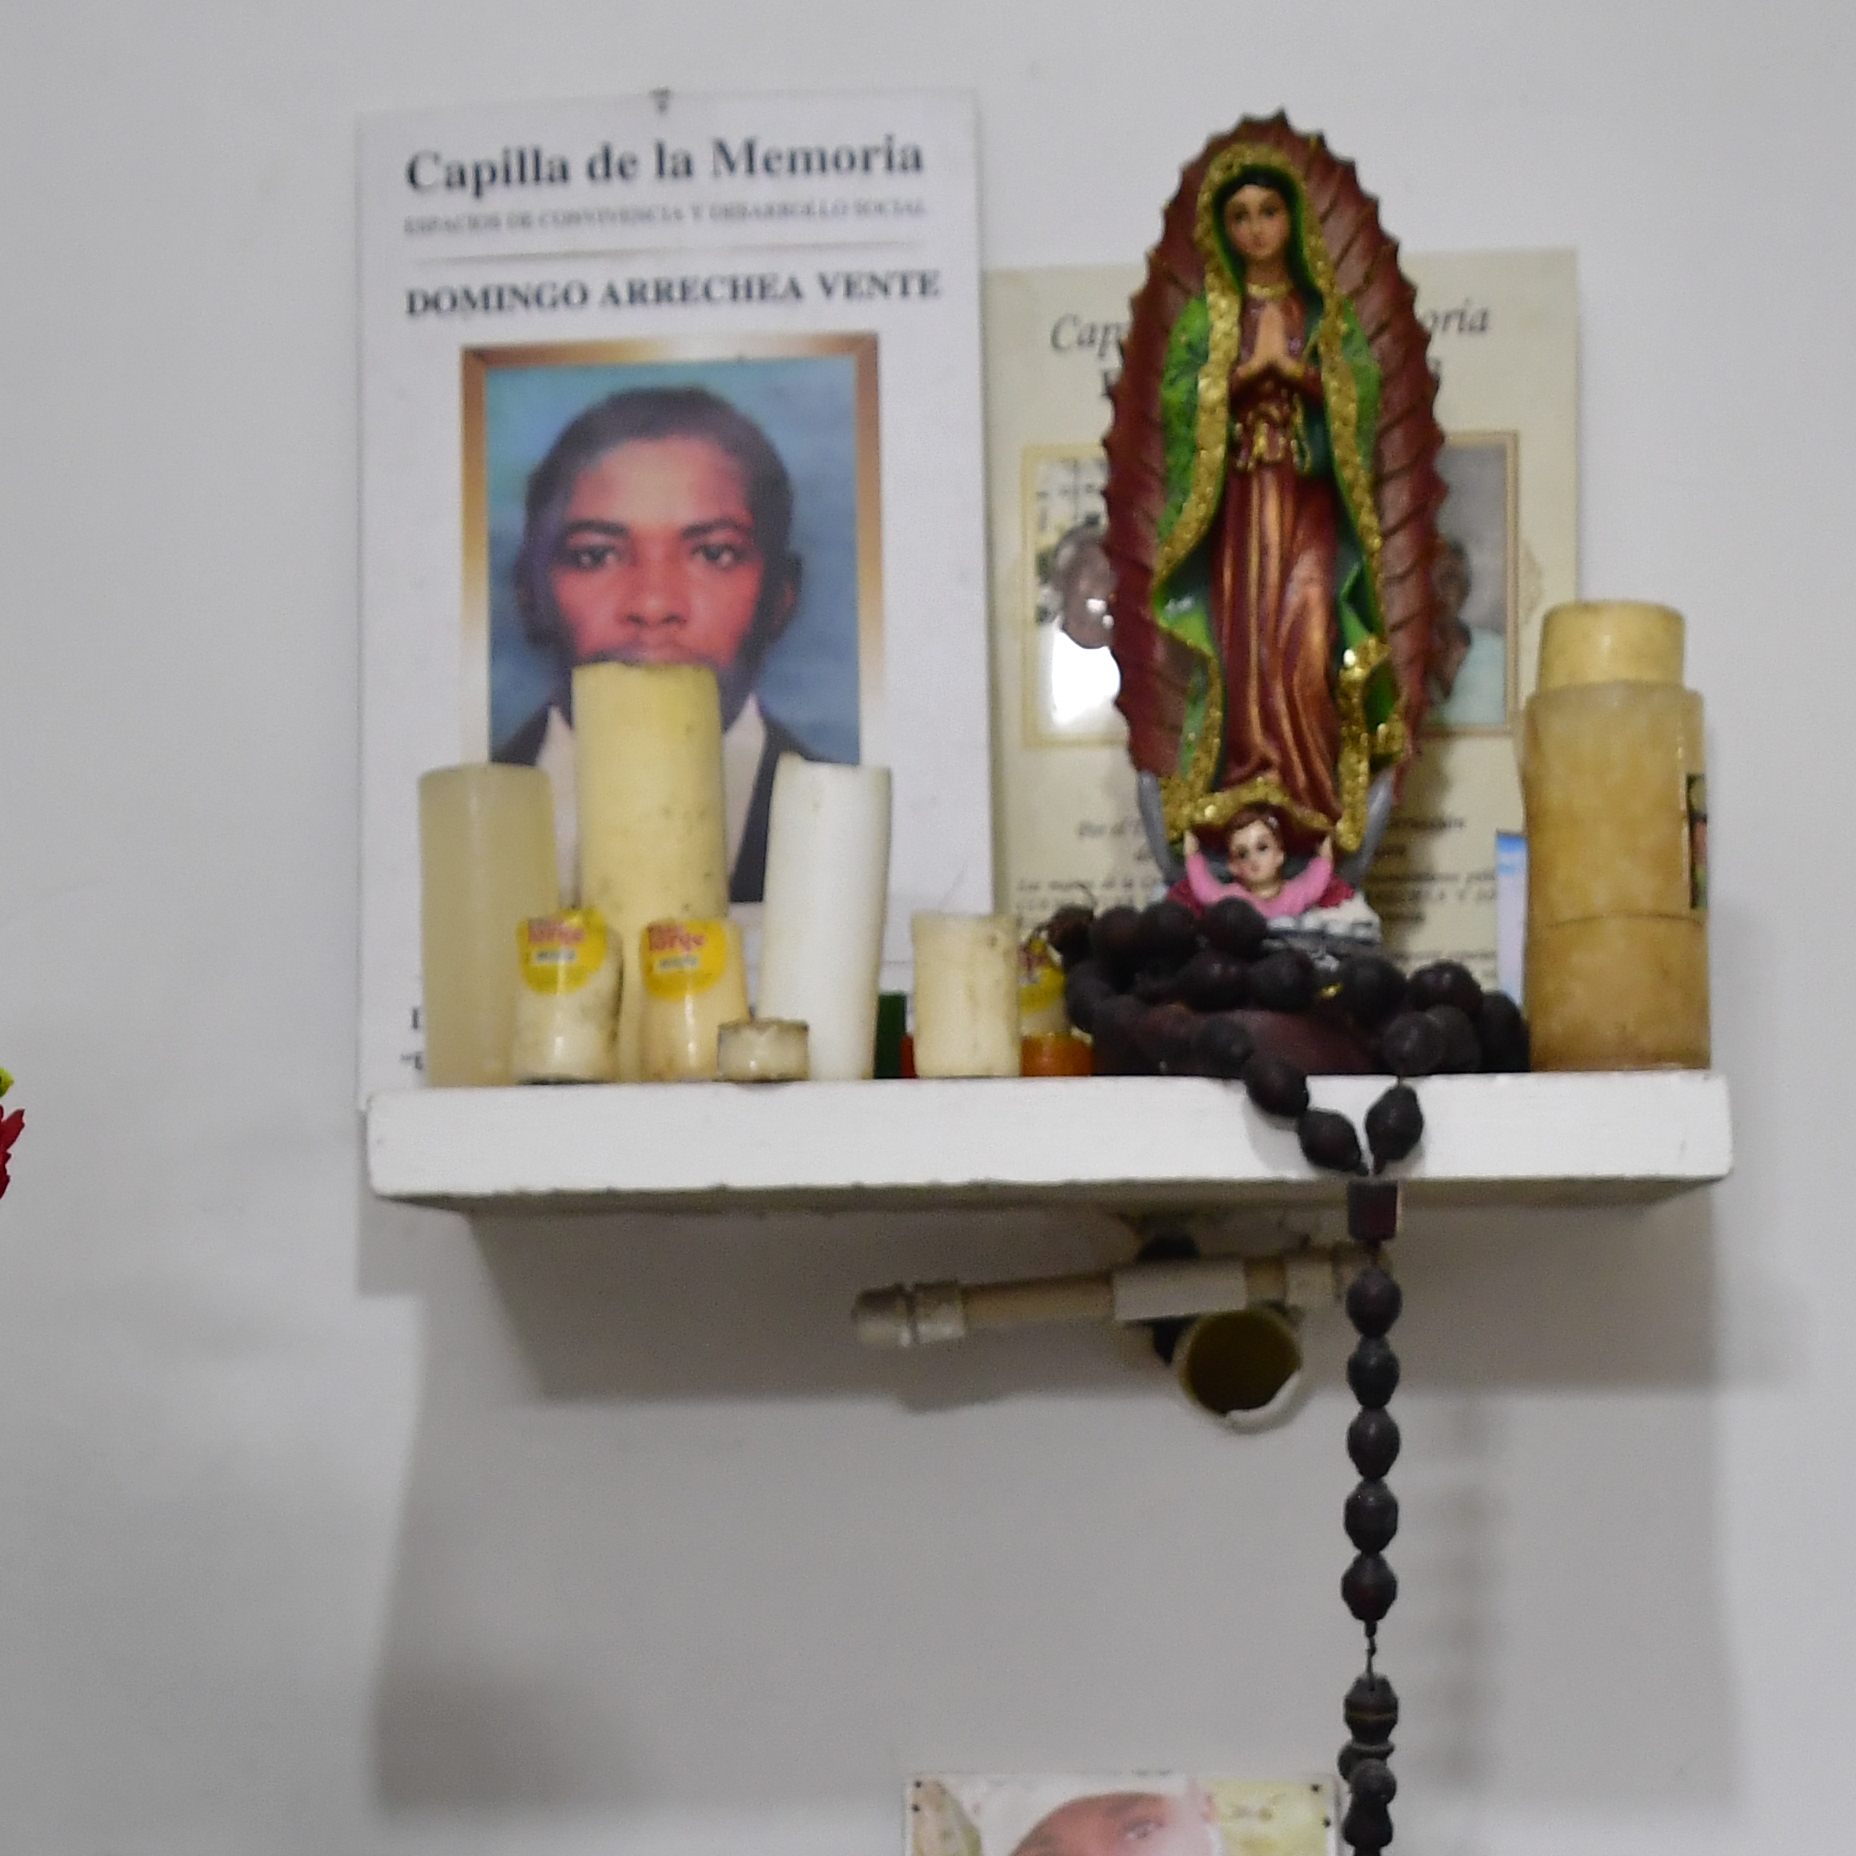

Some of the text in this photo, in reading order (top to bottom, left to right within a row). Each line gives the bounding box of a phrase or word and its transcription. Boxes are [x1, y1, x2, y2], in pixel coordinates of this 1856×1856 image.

[406, 133, 924, 199] Capilla de la Memoria
[406, 268, 940, 316] DOMINGO ARRECHEA VENTE
